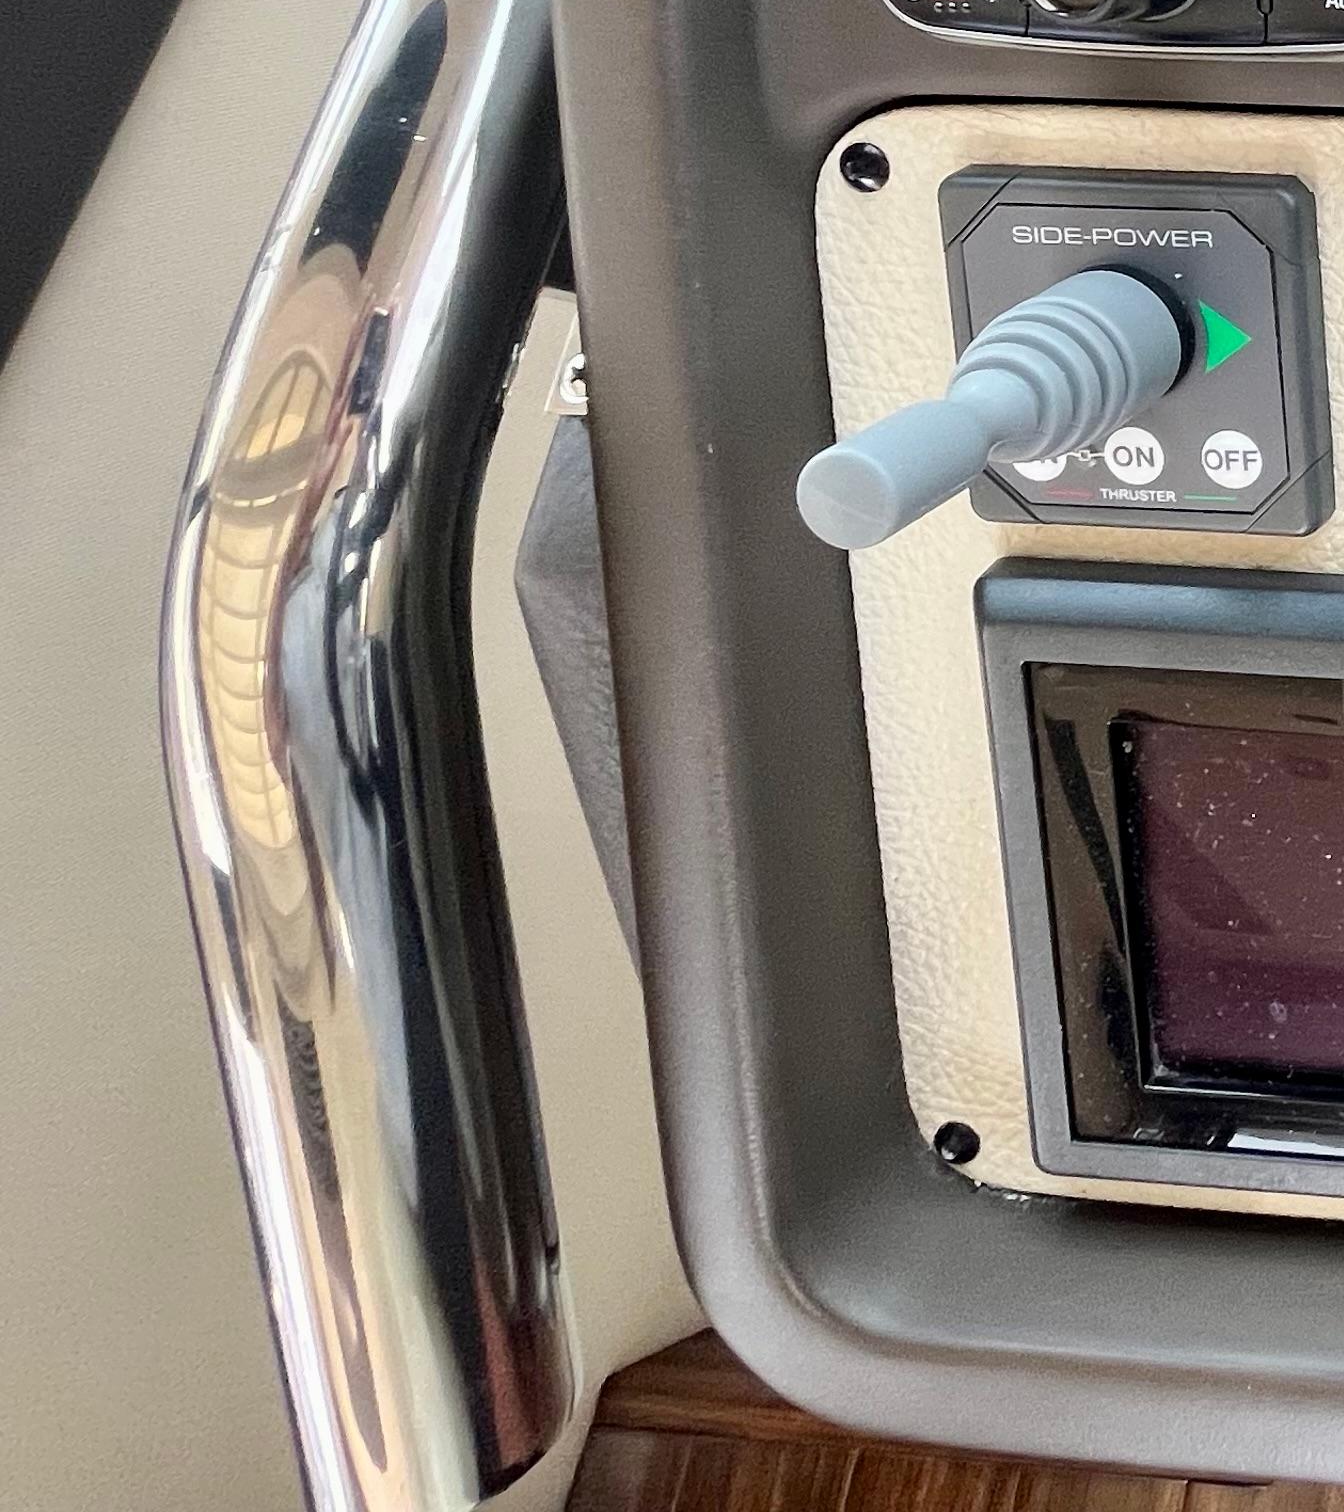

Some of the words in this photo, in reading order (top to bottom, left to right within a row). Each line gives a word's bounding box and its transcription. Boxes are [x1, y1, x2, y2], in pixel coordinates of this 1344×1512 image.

[1012, 226, 1214, 249] SIDE-POWER
[1112, 445, 1155, 468] ON
[1204, 448, 1258, 472] OFF
[1100, 488, 1177, 503] THRUSTER
